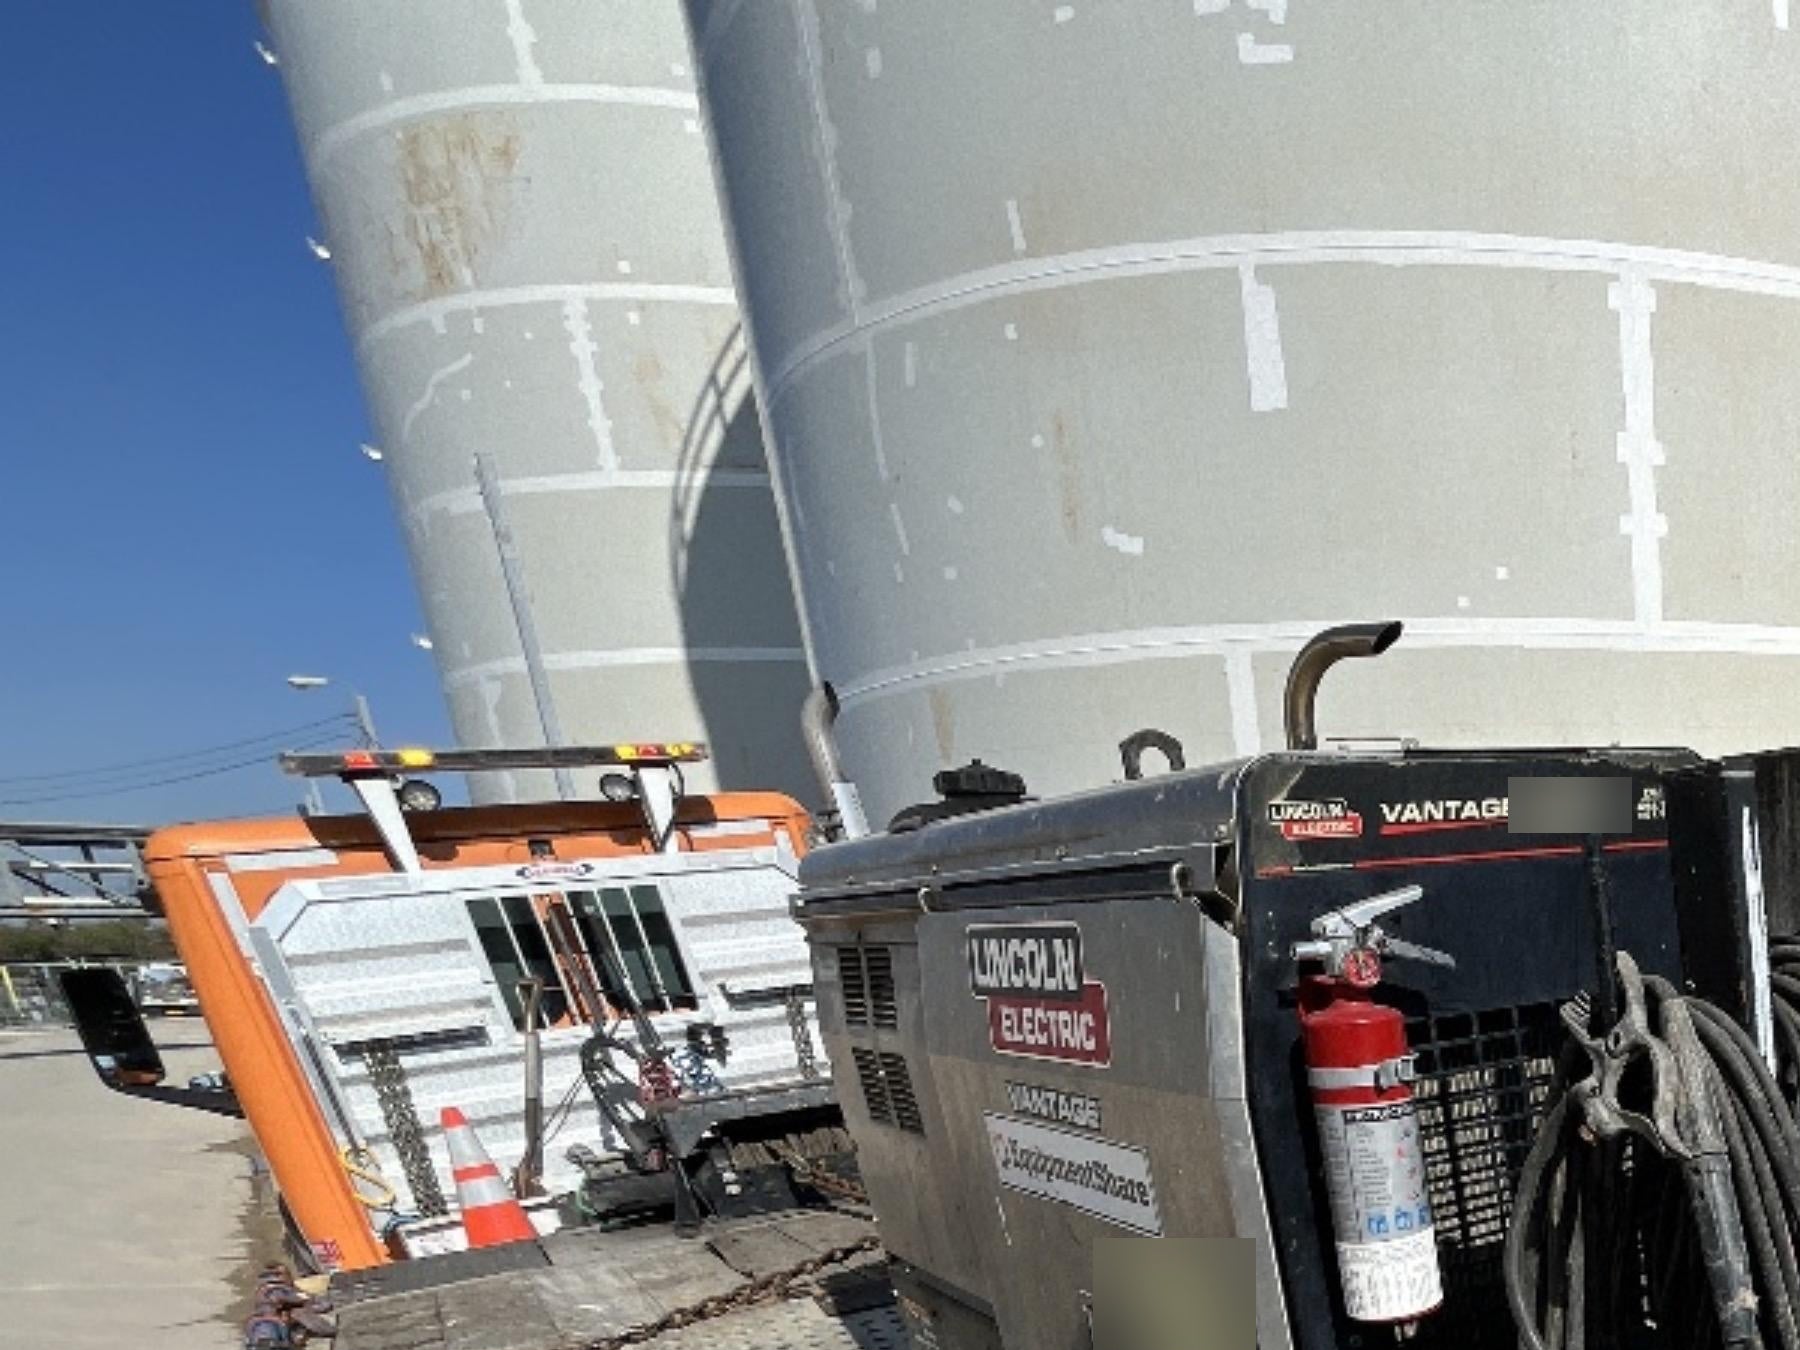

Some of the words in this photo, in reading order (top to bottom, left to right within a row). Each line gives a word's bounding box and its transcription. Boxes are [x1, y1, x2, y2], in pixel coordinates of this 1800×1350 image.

[970, 937, 1079, 992] LINCOLN
[1000, 1005, 1097, 1052] ELECTRIC
[1006, 1080, 1102, 1131] VANTAGE
